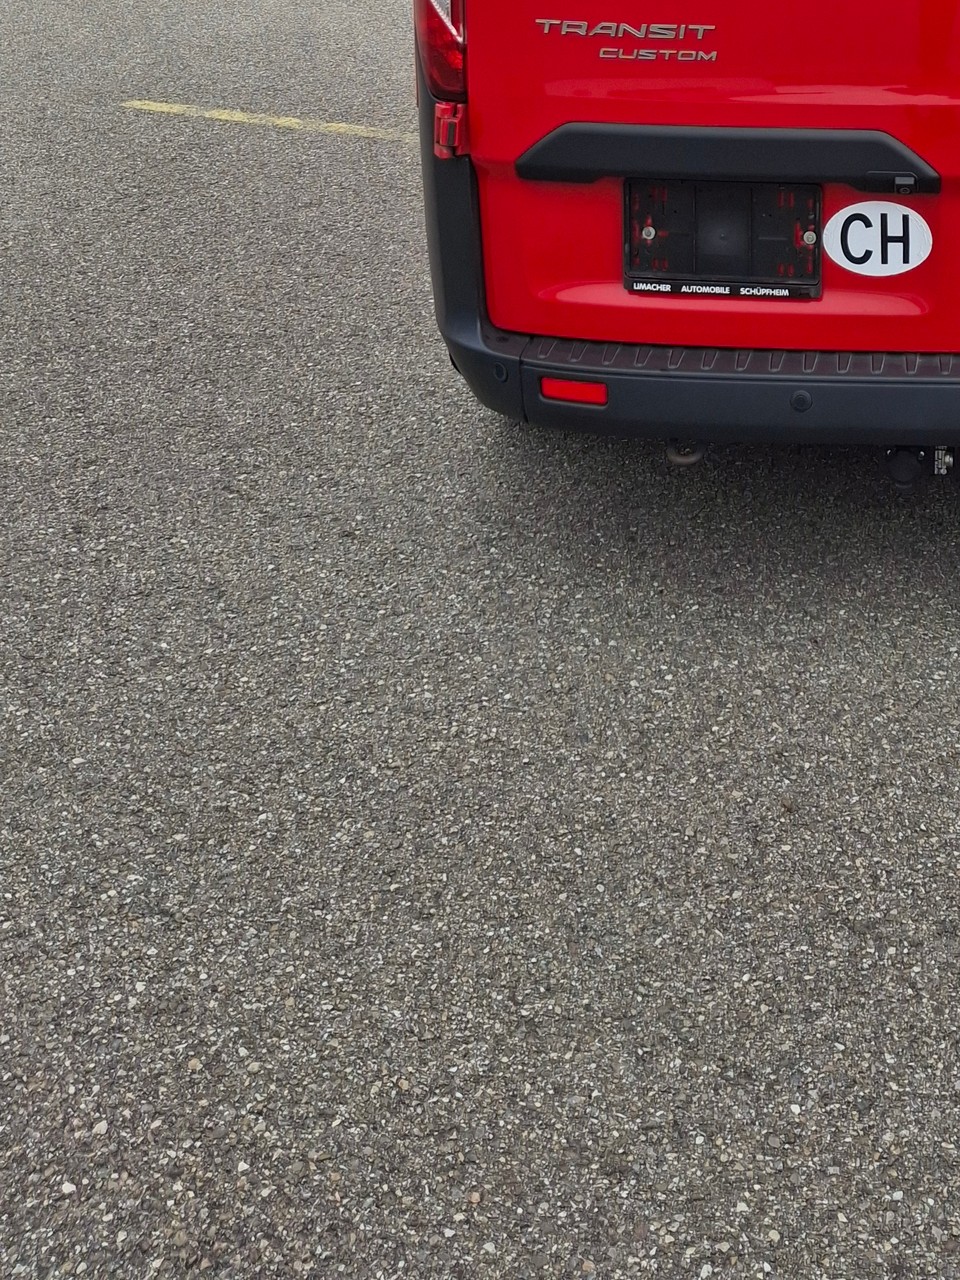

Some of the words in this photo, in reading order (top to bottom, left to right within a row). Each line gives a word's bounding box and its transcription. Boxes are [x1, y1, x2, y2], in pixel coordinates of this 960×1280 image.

[535, 19, 716, 40] TRANSIT
[599, 48, 718, 61] CUSTOM
[839, 213, 910, 265] CH
[633, 282, 672, 292] LIMACHER
[681, 285, 730, 294] AUTOMOBILE
[740, 286, 789, 297] SCHÜPFHEIM
